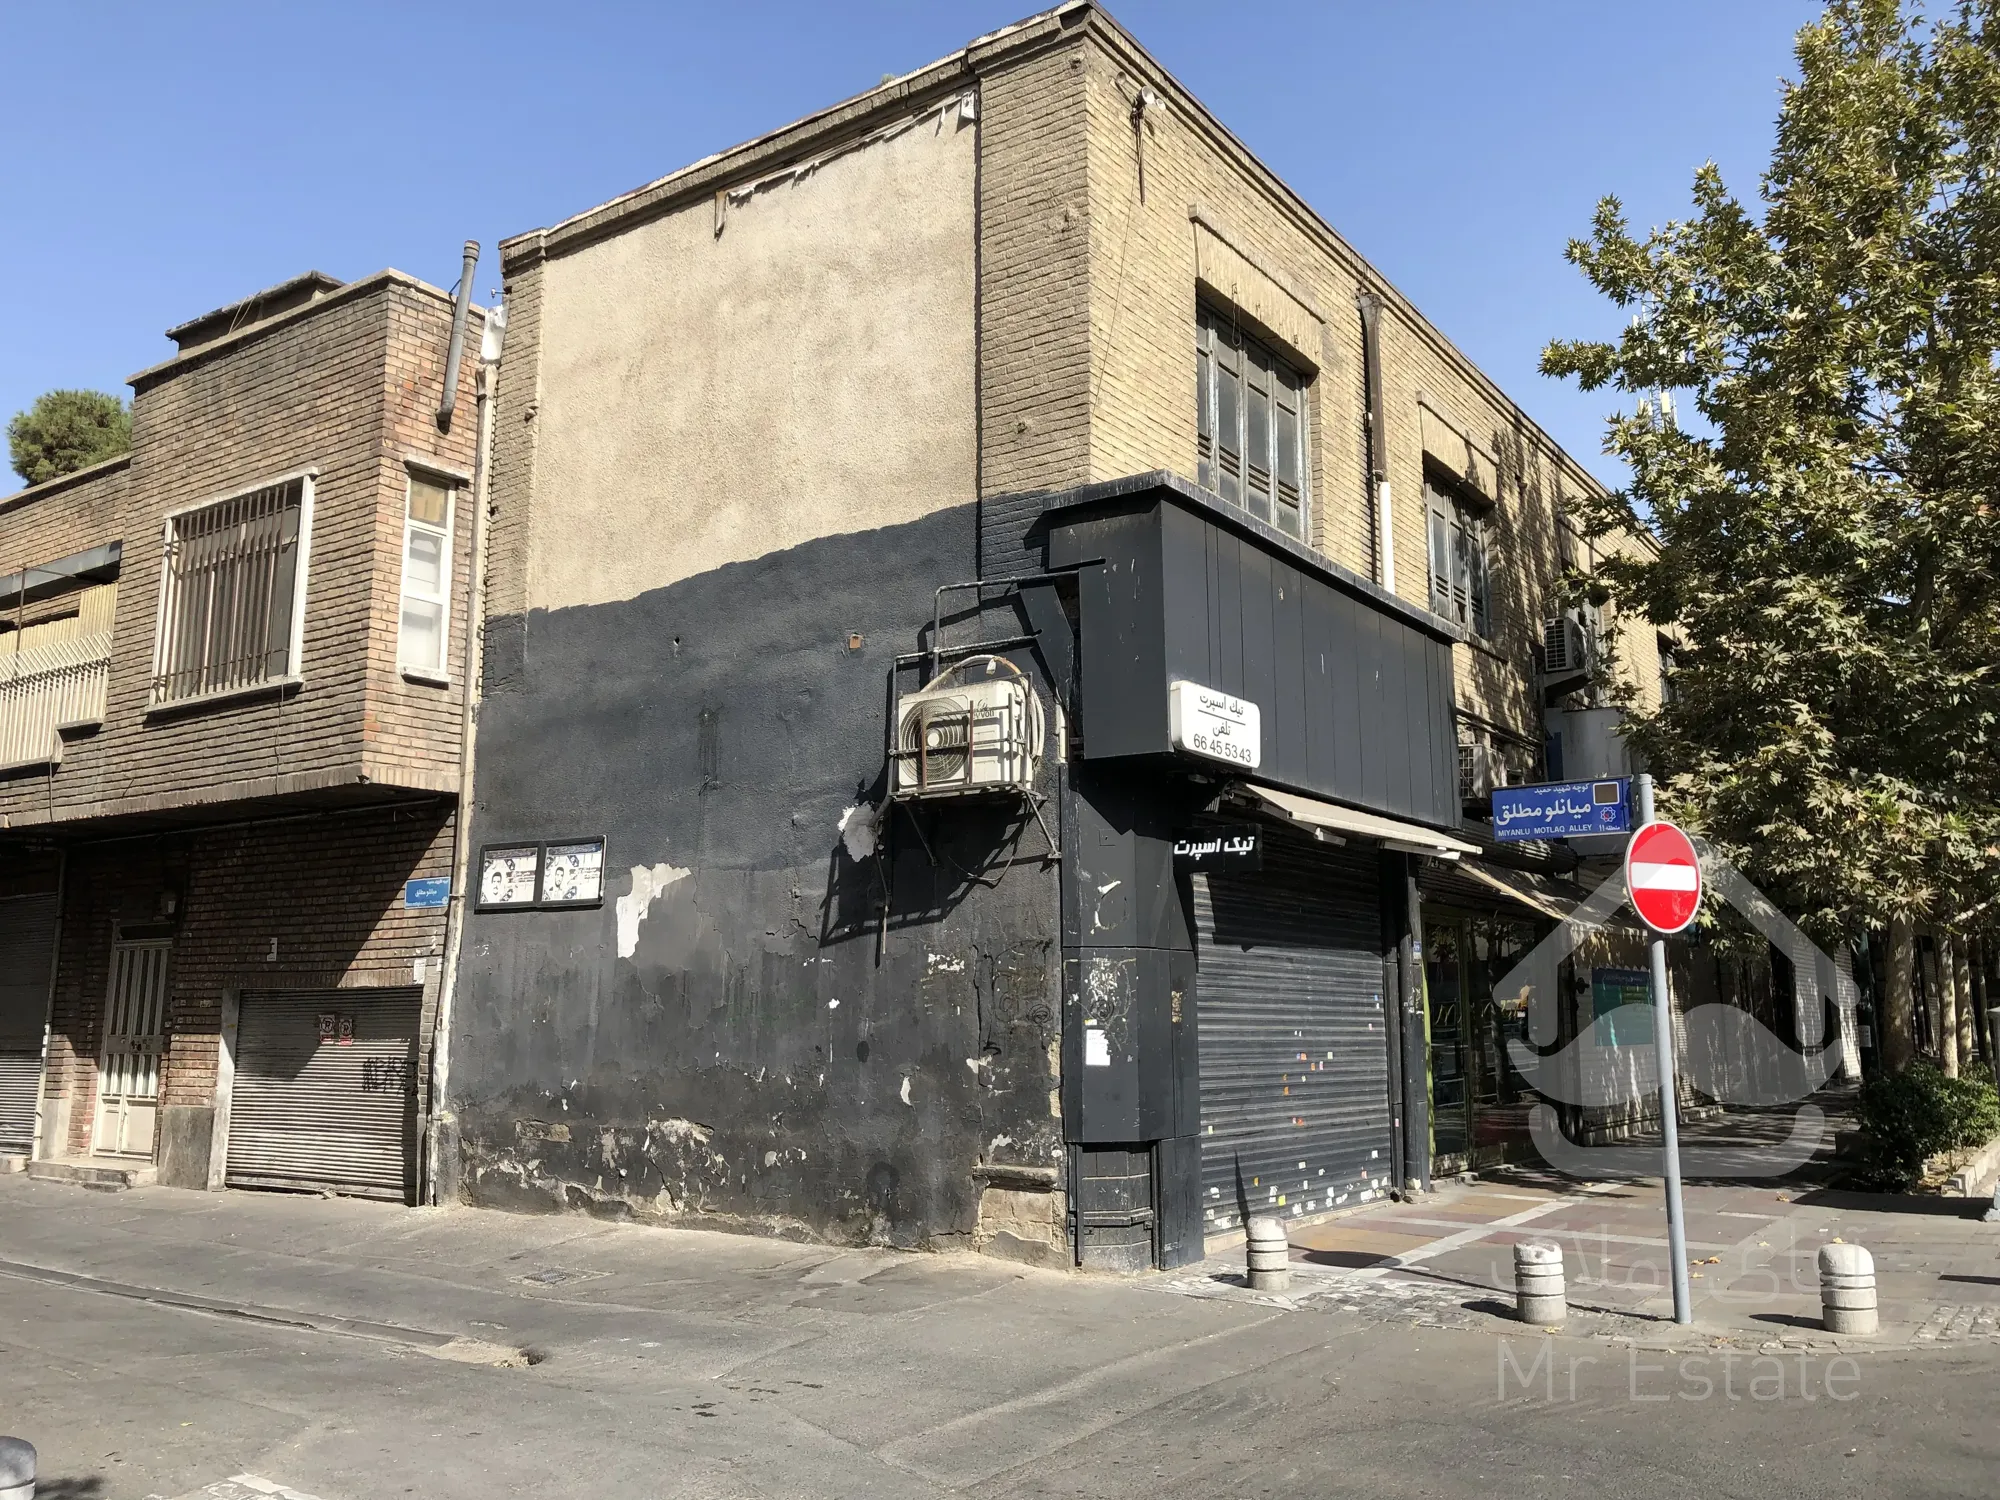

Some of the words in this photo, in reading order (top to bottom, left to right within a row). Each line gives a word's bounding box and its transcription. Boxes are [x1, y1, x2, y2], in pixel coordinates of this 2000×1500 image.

[1199, 695, 1227, 712] اسپرت
[1212, 720, 1231, 737] تلفن
[1553, 784, 1571, 794] شهید
[1572, 783, 1590, 793] کوچه
[1496, 803, 1542, 826] مطلق
[1545, 798, 1592, 823] میانلو
[1498, 828, 1530, 837] MIYANLU
[1534, 825, 1566, 834] MOTLAQ
[1569, 824, 1592, 832] ALLEY
[1173, 838, 1221, 861] اسپرت
[1223, 836, 1255, 856] تیک
